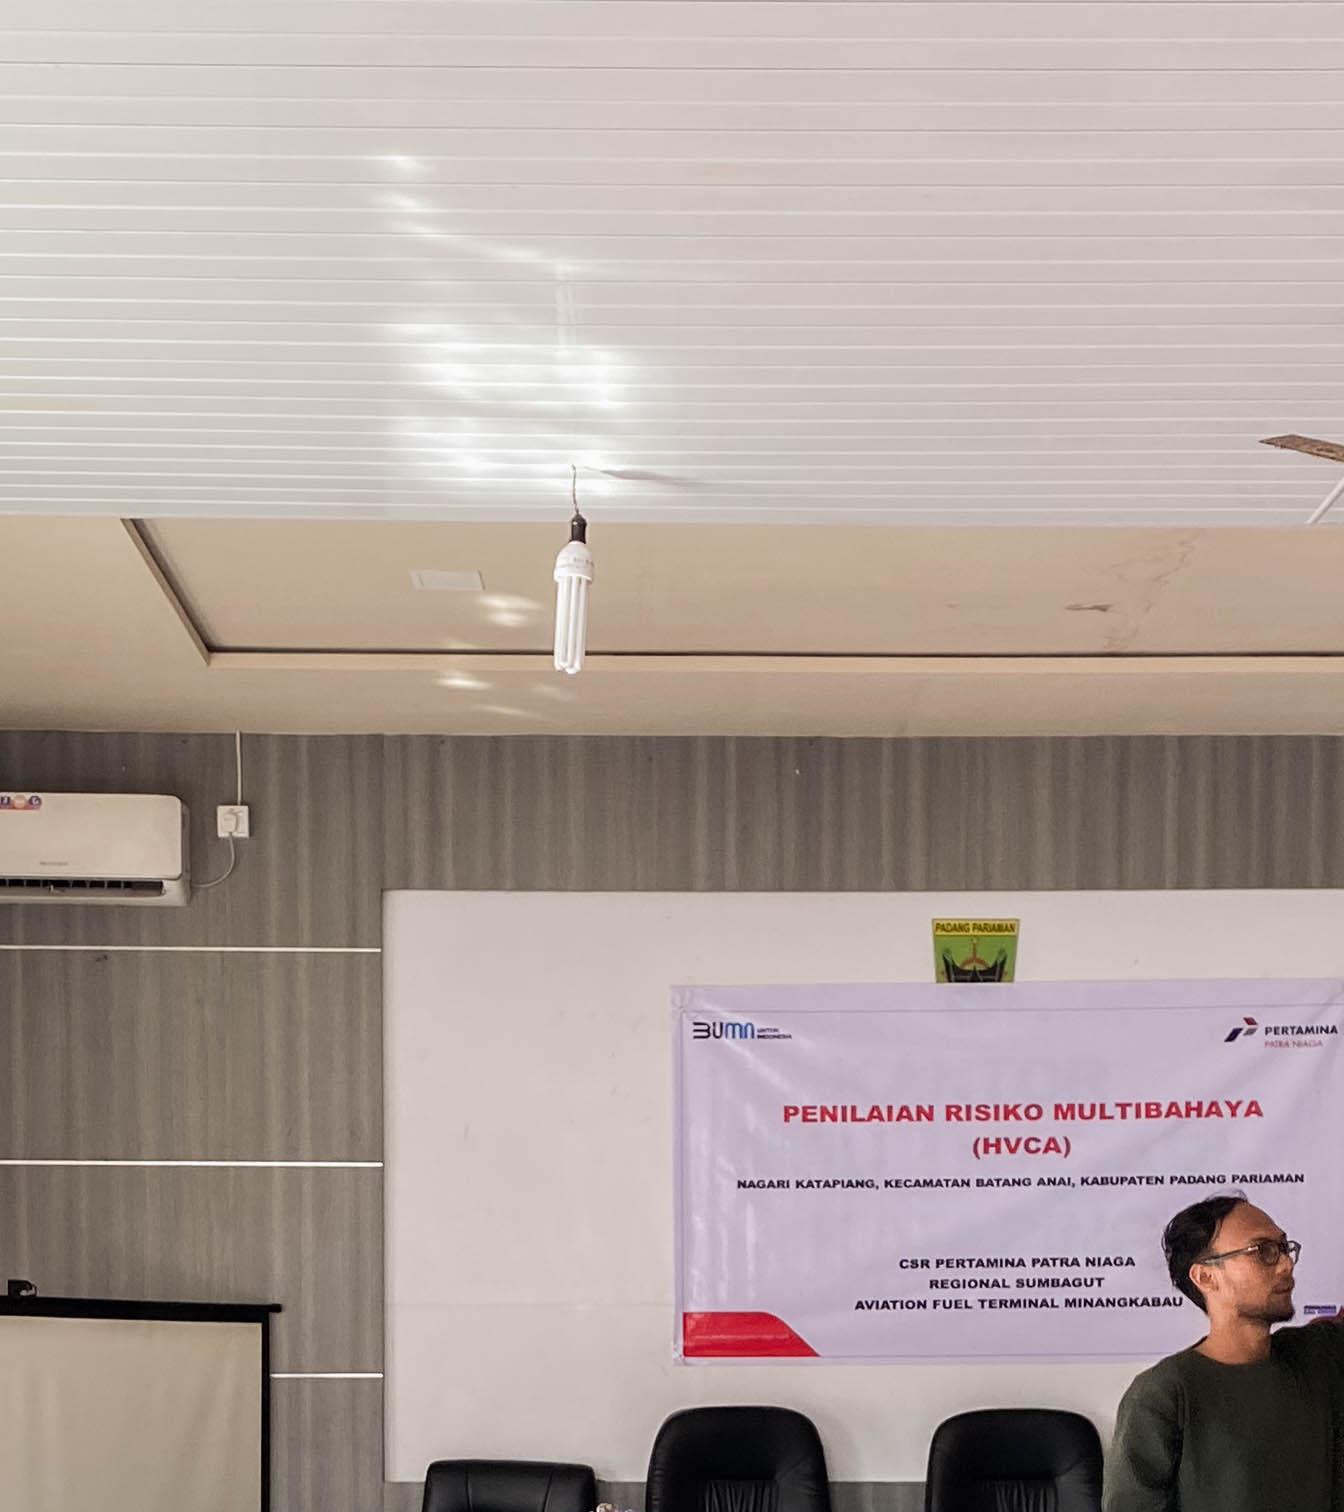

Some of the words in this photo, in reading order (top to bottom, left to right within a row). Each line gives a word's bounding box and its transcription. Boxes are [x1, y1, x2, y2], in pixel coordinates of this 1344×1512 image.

[935, 922, 971, 933] PADANG
[972, 922, 1015, 933] PARIAMAN
[1264, 1024, 1338, 1036] PERTAMINA
[783, 1104, 935, 1123] PENILAIAN
[945, 1103, 1044, 1122] RISIKO
[1053, 1100, 1264, 1121] MULTIBAHAYA
[972, 1136, 1071, 1160] (HVCA)
[736, 1179, 791, 1190] NAGARI
[795, 1178, 880, 1191] KATAPIANG,
[883, 1178, 971, 1189] KECAMATAN
[975, 1177, 1032, 1188] BATANG
[1036, 1176, 1076, 1189] ANAI,
[1080, 1175, 1165, 1187] KABUPATEN
[1169, 1174, 1227, 1185] PADANG
[1231, 1173, 1305, 1184] PARIAMAN
[898, 1258, 931, 1270] CSR
[935, 1257, 1027, 1269] PERTAMINA
[1031, 1257, 1081, 1268] PATRA
[1085, 1256, 1136, 1267] NIAGA
[928, 1278, 1011, 1289] REGIONAL
[1015, 1277, 1106, 1288] SUMBAGUT
[854, 1299, 928, 1311] AVIATION
[932, 1298, 974, 1310] FUEL
[977, 1297, 1060, 1309] TERMINAL
[1064, 1296, 1184, 1308] MINANGKABAU
